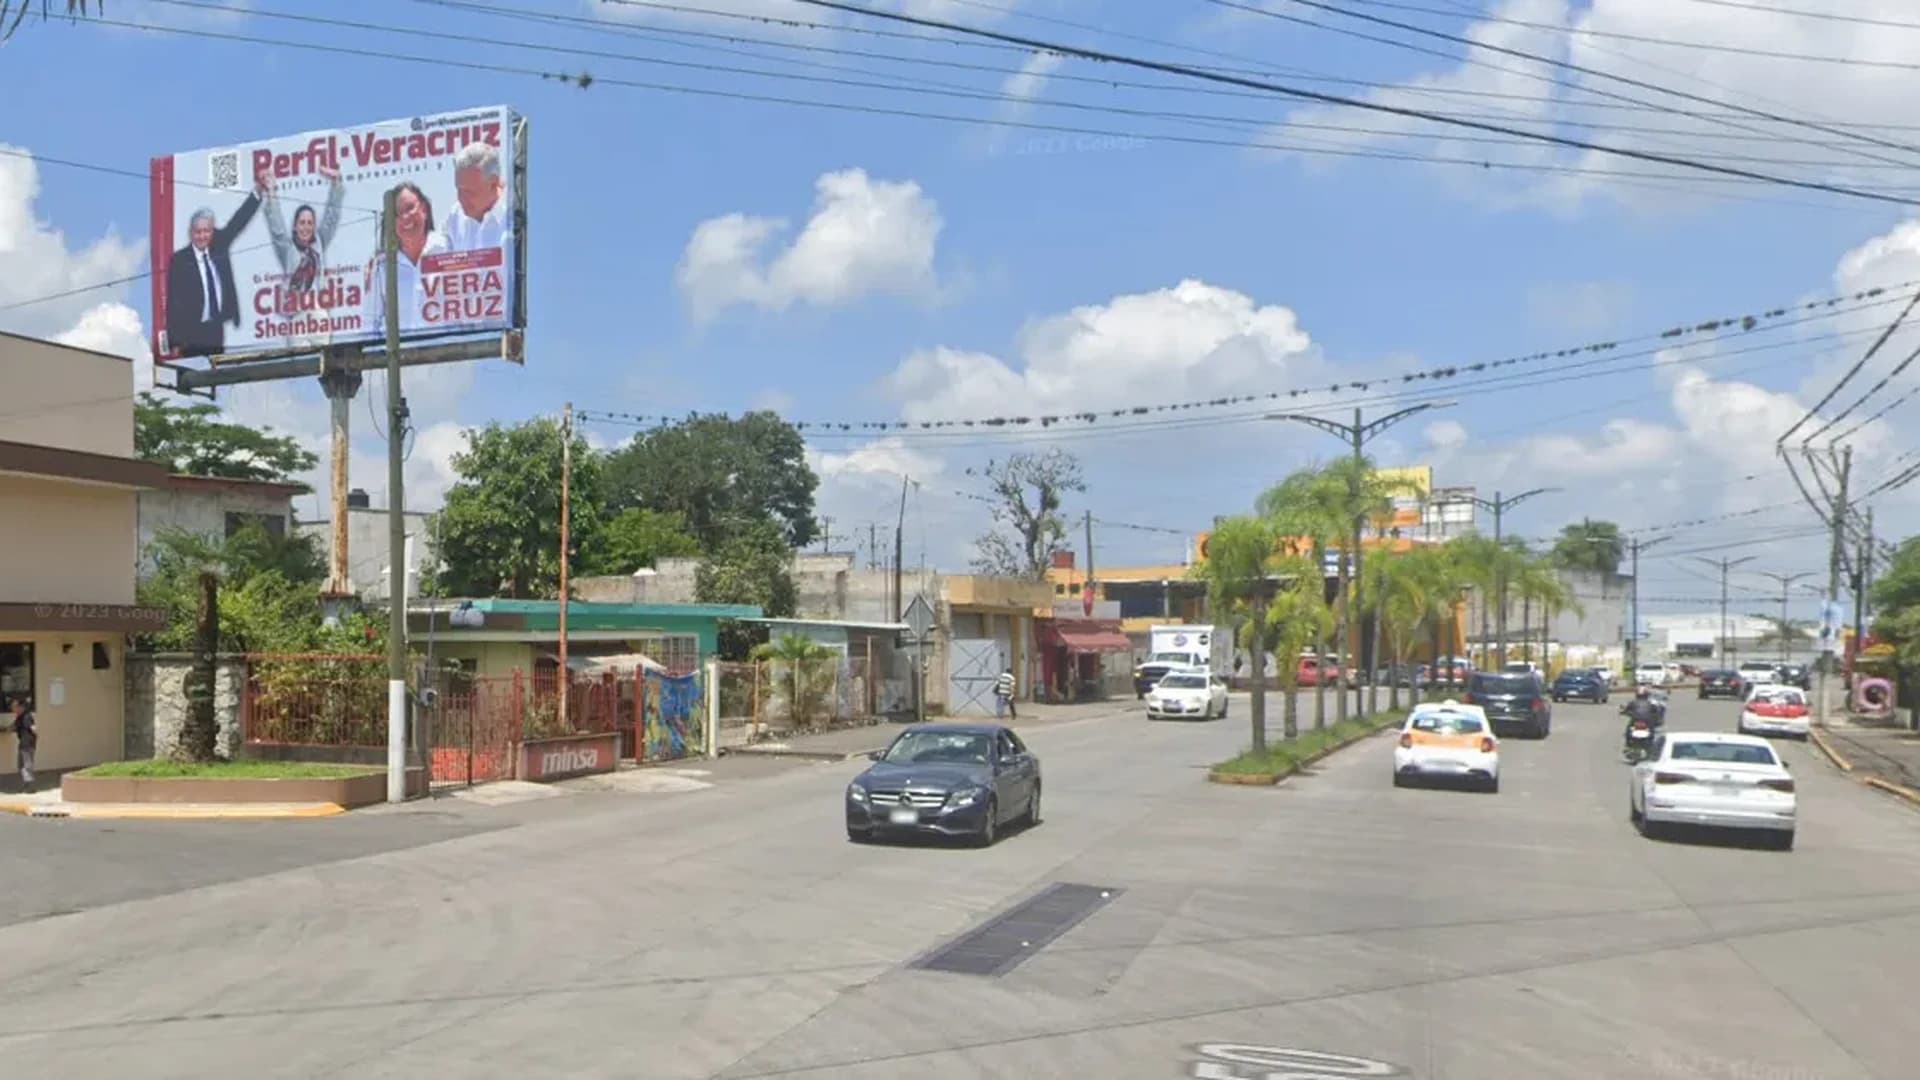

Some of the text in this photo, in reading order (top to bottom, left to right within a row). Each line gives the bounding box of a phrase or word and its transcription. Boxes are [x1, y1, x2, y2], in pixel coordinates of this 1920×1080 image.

[254, 277, 362, 316] Claudia
[421, 270, 502, 298] VERA
[422, 295, 503, 322] CRUZ
[254, 314, 362, 339] Sheinbaum
[541, 745, 598, 775] minsa
